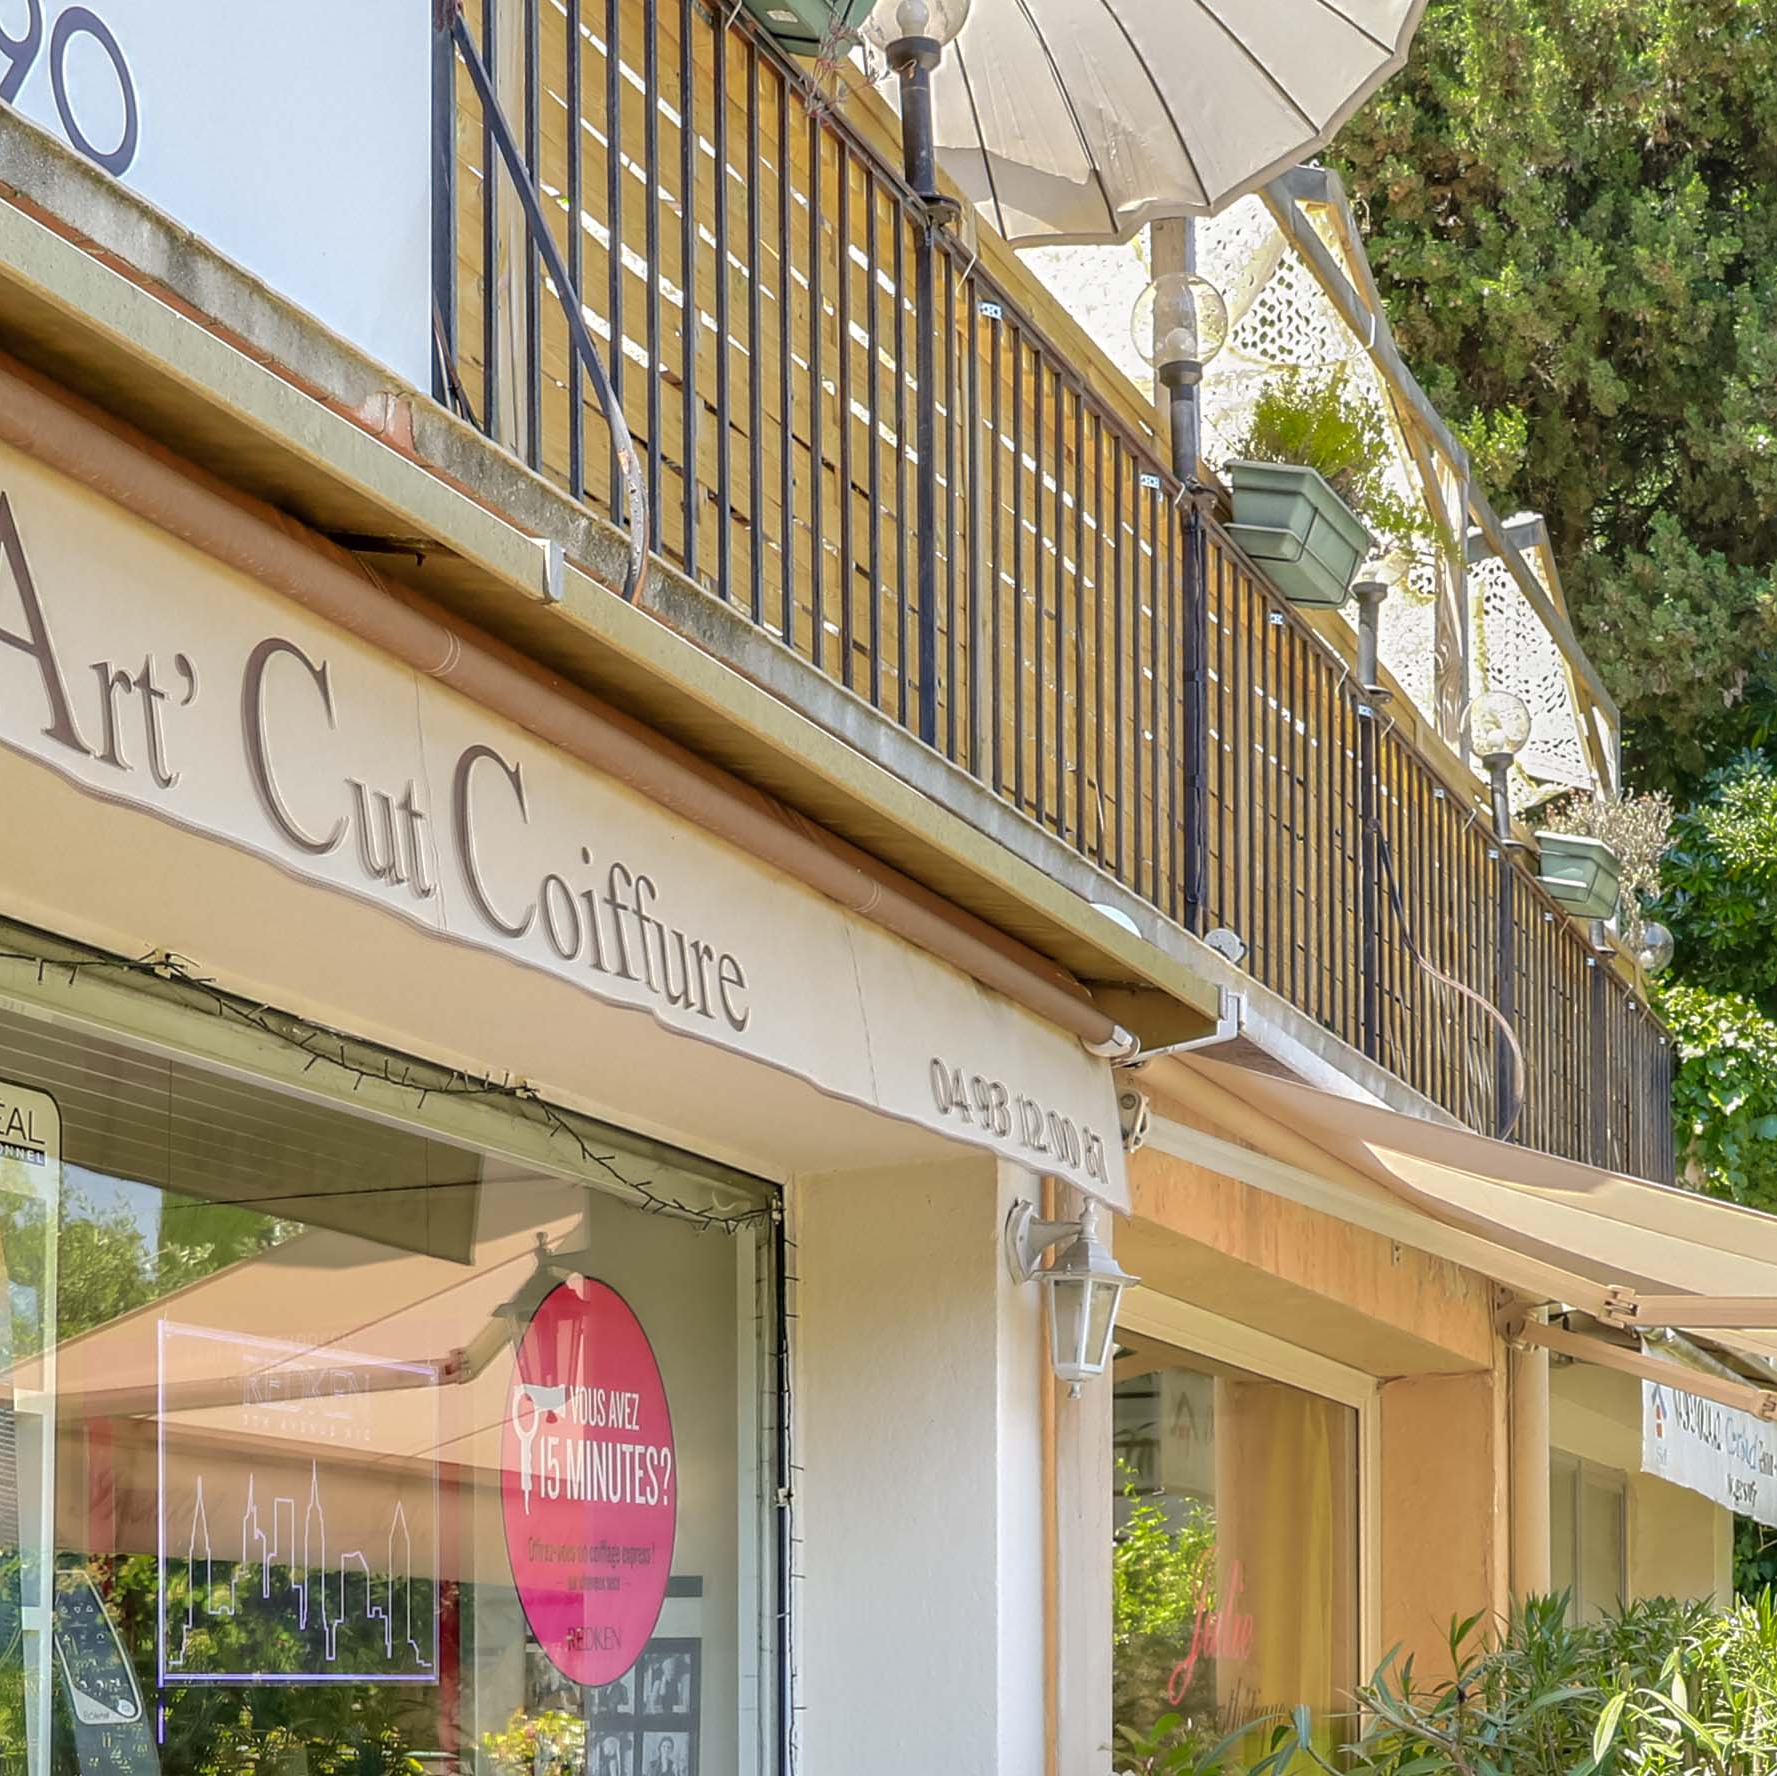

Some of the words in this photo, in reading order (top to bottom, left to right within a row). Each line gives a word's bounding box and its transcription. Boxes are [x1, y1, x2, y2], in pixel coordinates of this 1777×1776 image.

[241, 637, 438, 899] Cut
[453, 744, 750, 1032] Coiffure
[930, 1056, 974, 1123] 04
[971, 1074, 1012, 1138] 93
[1048, 1110, 1081, 1169] 00
[570, 1384, 606, 1428] VOUS
[608, 1390, 640, 1431] AVEZ
[539, 1436, 560, 1500] 15
[567, 1438, 671, 1506] MINUTES?
[567, 1626, 622, 1651] REDKEN
